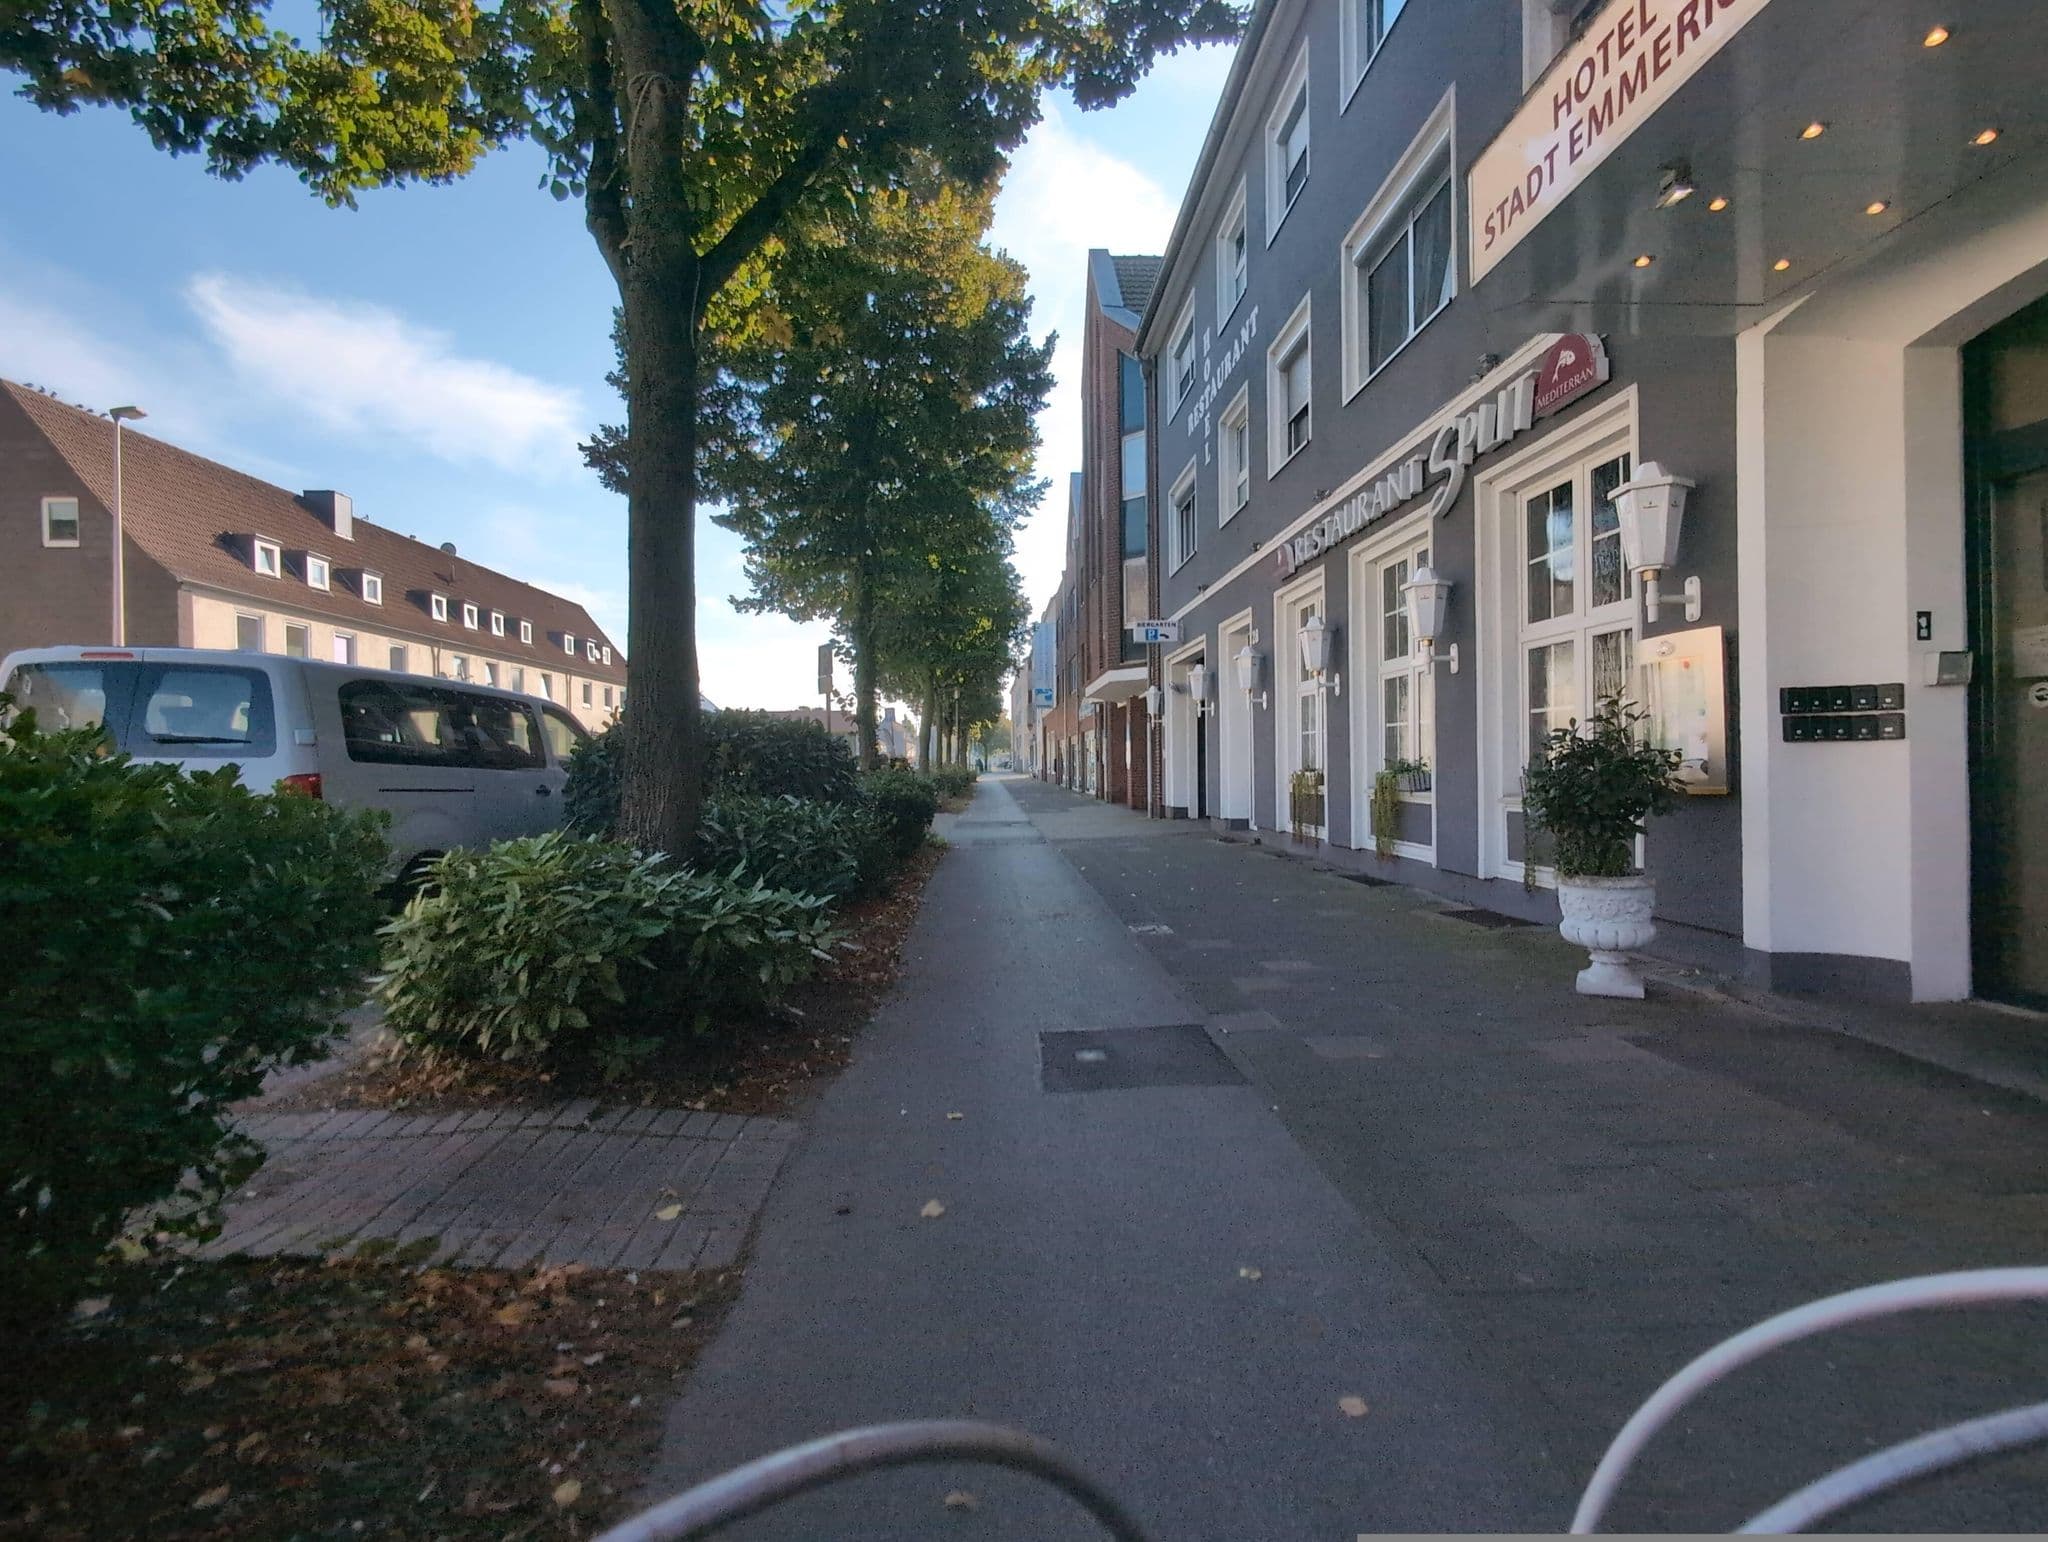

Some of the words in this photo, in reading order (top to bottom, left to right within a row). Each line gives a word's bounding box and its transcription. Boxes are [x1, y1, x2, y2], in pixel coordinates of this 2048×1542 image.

[1484, 141, 1560, 251] STADT
[1569, 0, 1736, 166] EMMERI
[1553, 0, 1657, 130] HOTEL
[1187, 304, 1259, 437] RESTAURANT
[1203, 327, 1211, 466] HOTEL
[1537, 367, 1593, 408] MEDITERRAN
[1294, 454, 1428, 567] RESTAURANT
